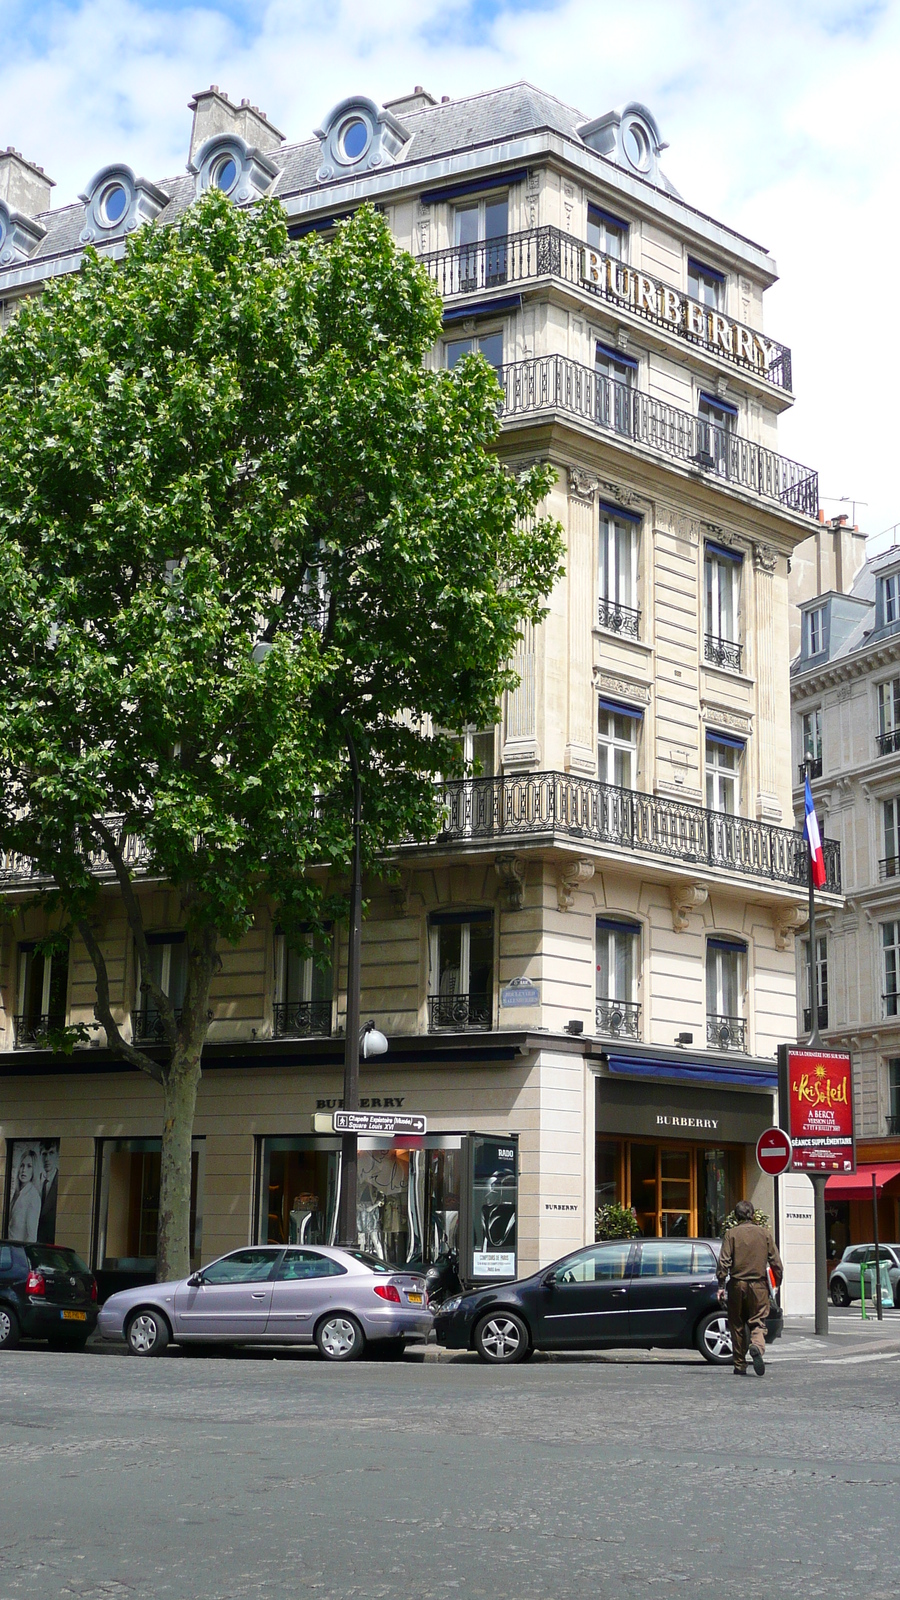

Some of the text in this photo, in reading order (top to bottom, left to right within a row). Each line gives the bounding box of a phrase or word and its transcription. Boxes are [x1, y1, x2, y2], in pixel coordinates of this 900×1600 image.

[580, 247, 775, 371] BURBERRY
[798, 1074, 815, 1102] Roi
[812, 1077, 848, 1108] Soleil
[808, 1110, 835, 1119] A BERCY
[348, 1115, 369, 1123] Chapelle
[369, 1116, 393, 1124] Expiatoire
[656, 1115, 719, 1129] BURBERRY
[348, 1122, 367, 1130] Square
[791, 1136, 852, 1146] SÉANCE SUPPLÉMENTAIRE
[498, 1149, 514, 1158] RADO
